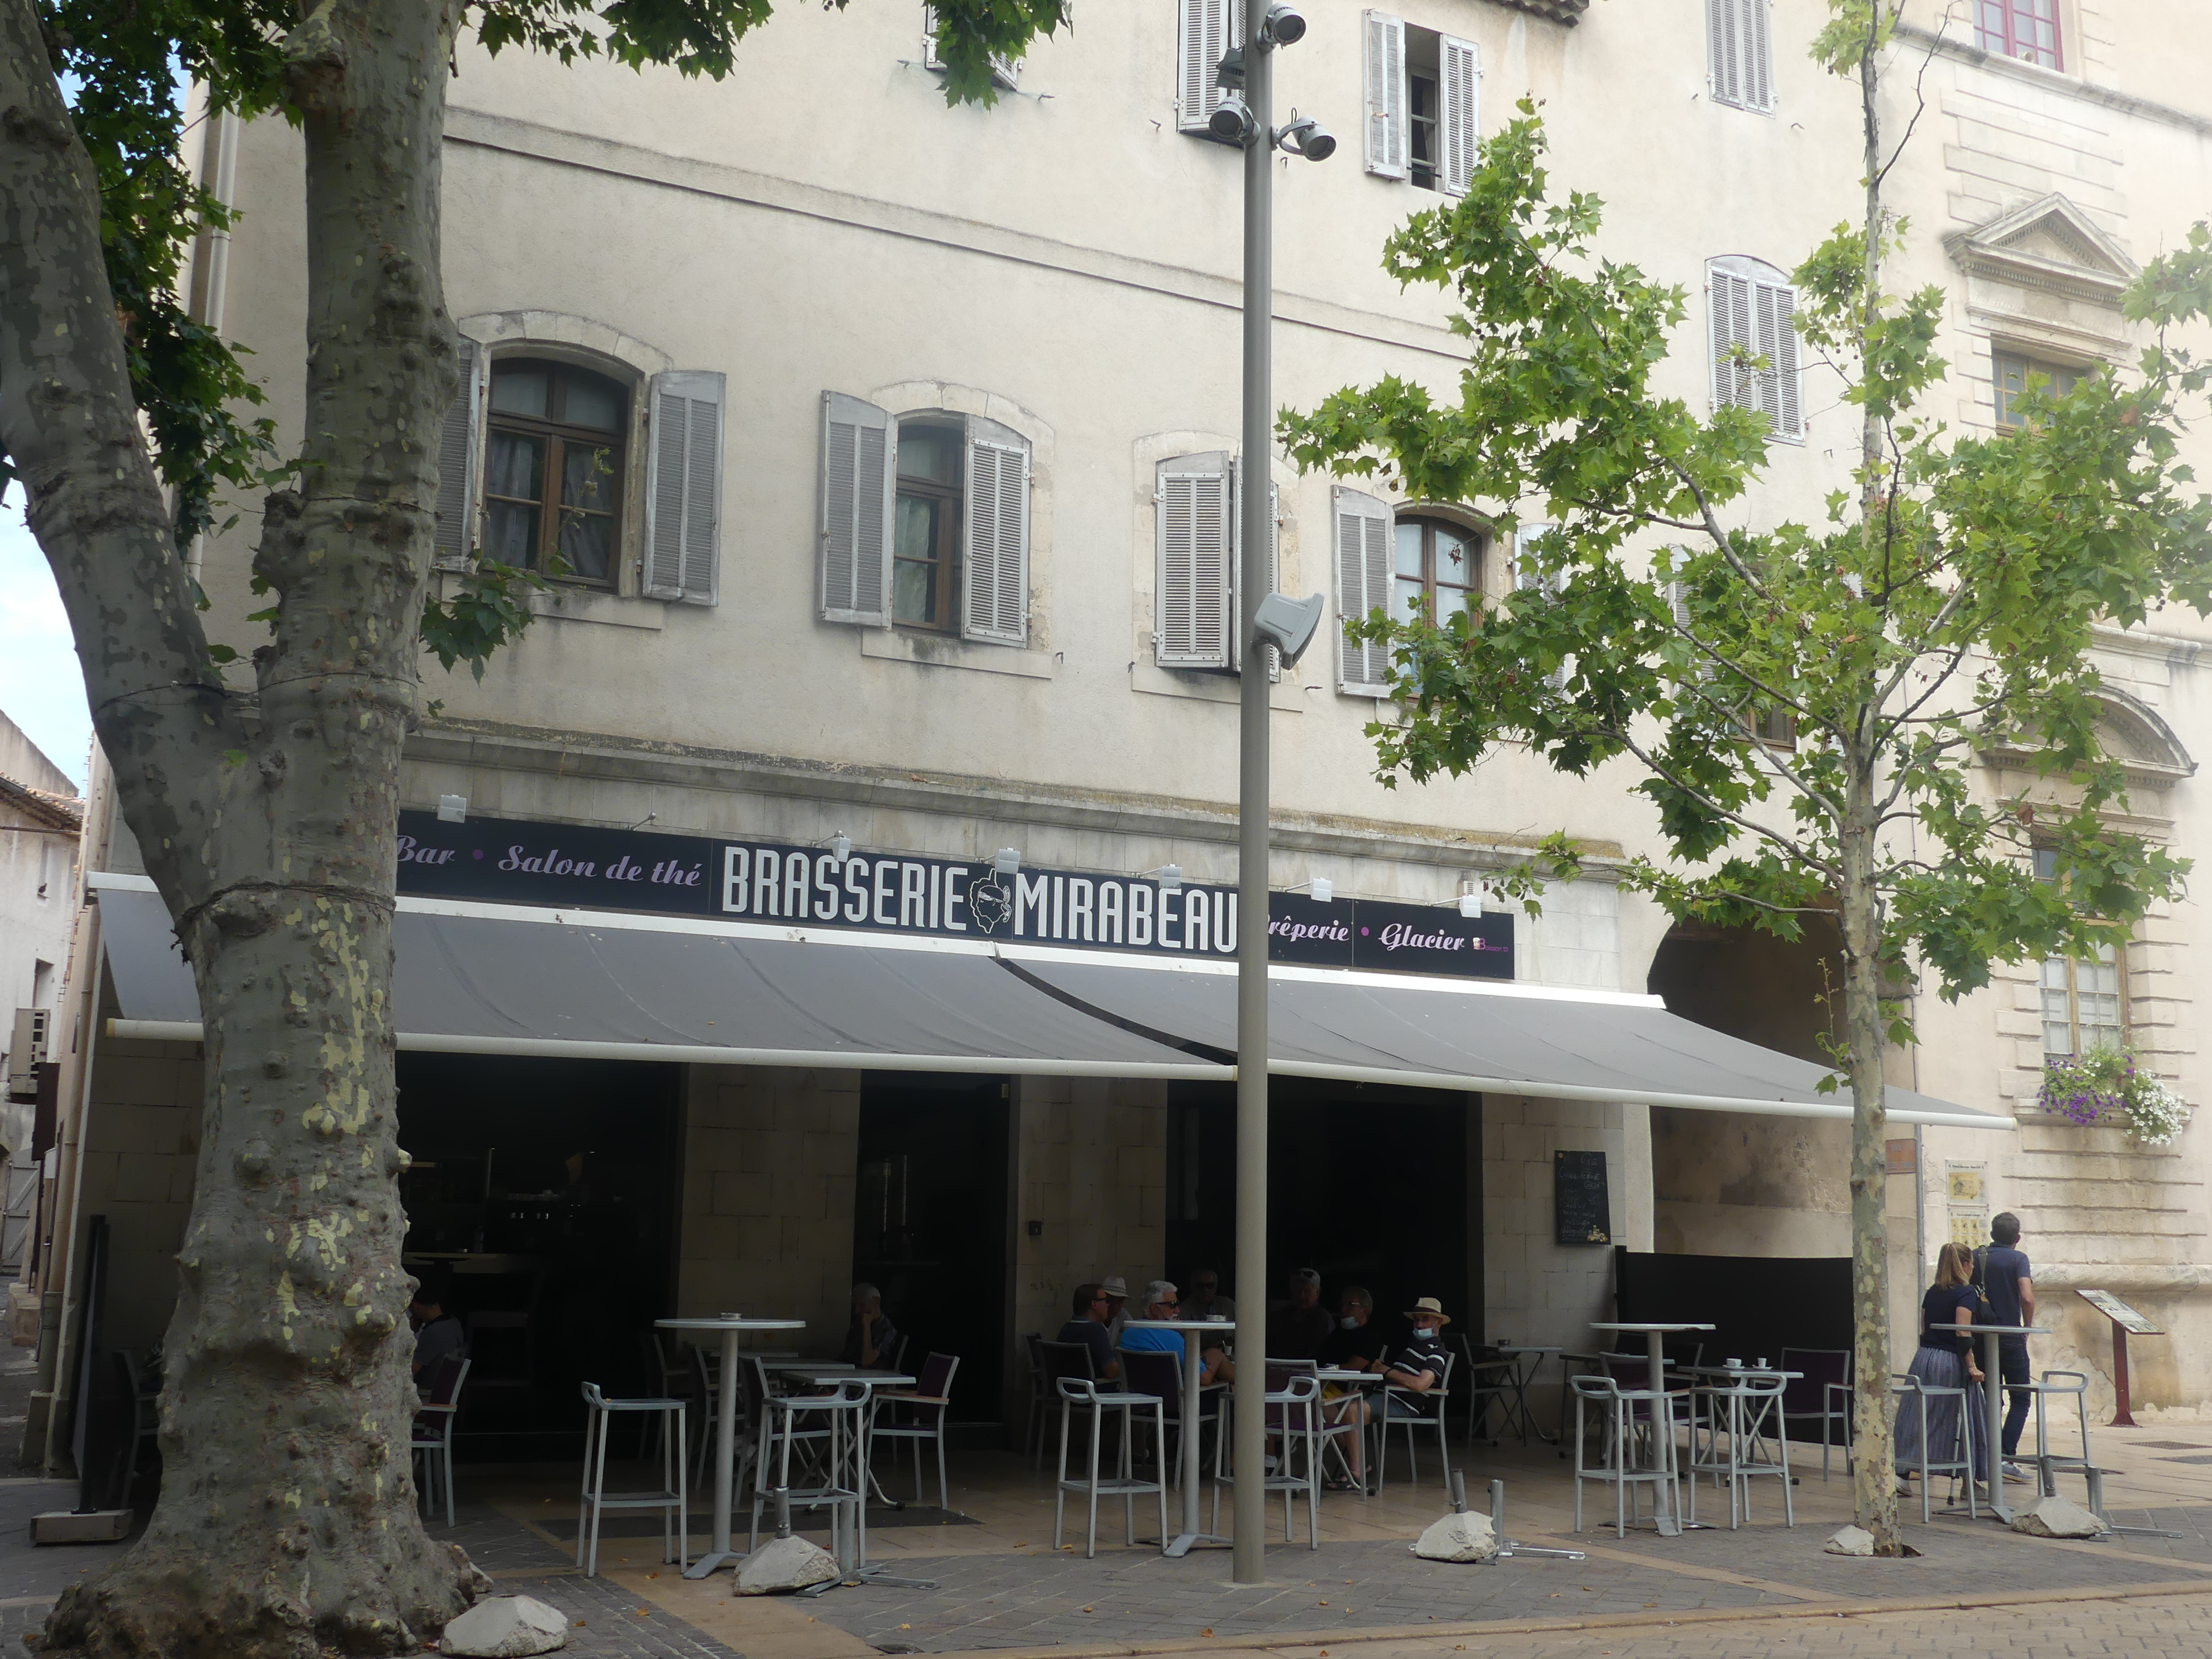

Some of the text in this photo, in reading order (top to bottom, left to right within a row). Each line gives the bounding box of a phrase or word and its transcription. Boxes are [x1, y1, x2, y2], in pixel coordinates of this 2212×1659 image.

[397, 835, 702, 886] Bar Salon de thé
[723, 847, 1238, 952] BRASSERIE MIRABEAU
[1268, 914, 1464, 951] rêperie Glacier
